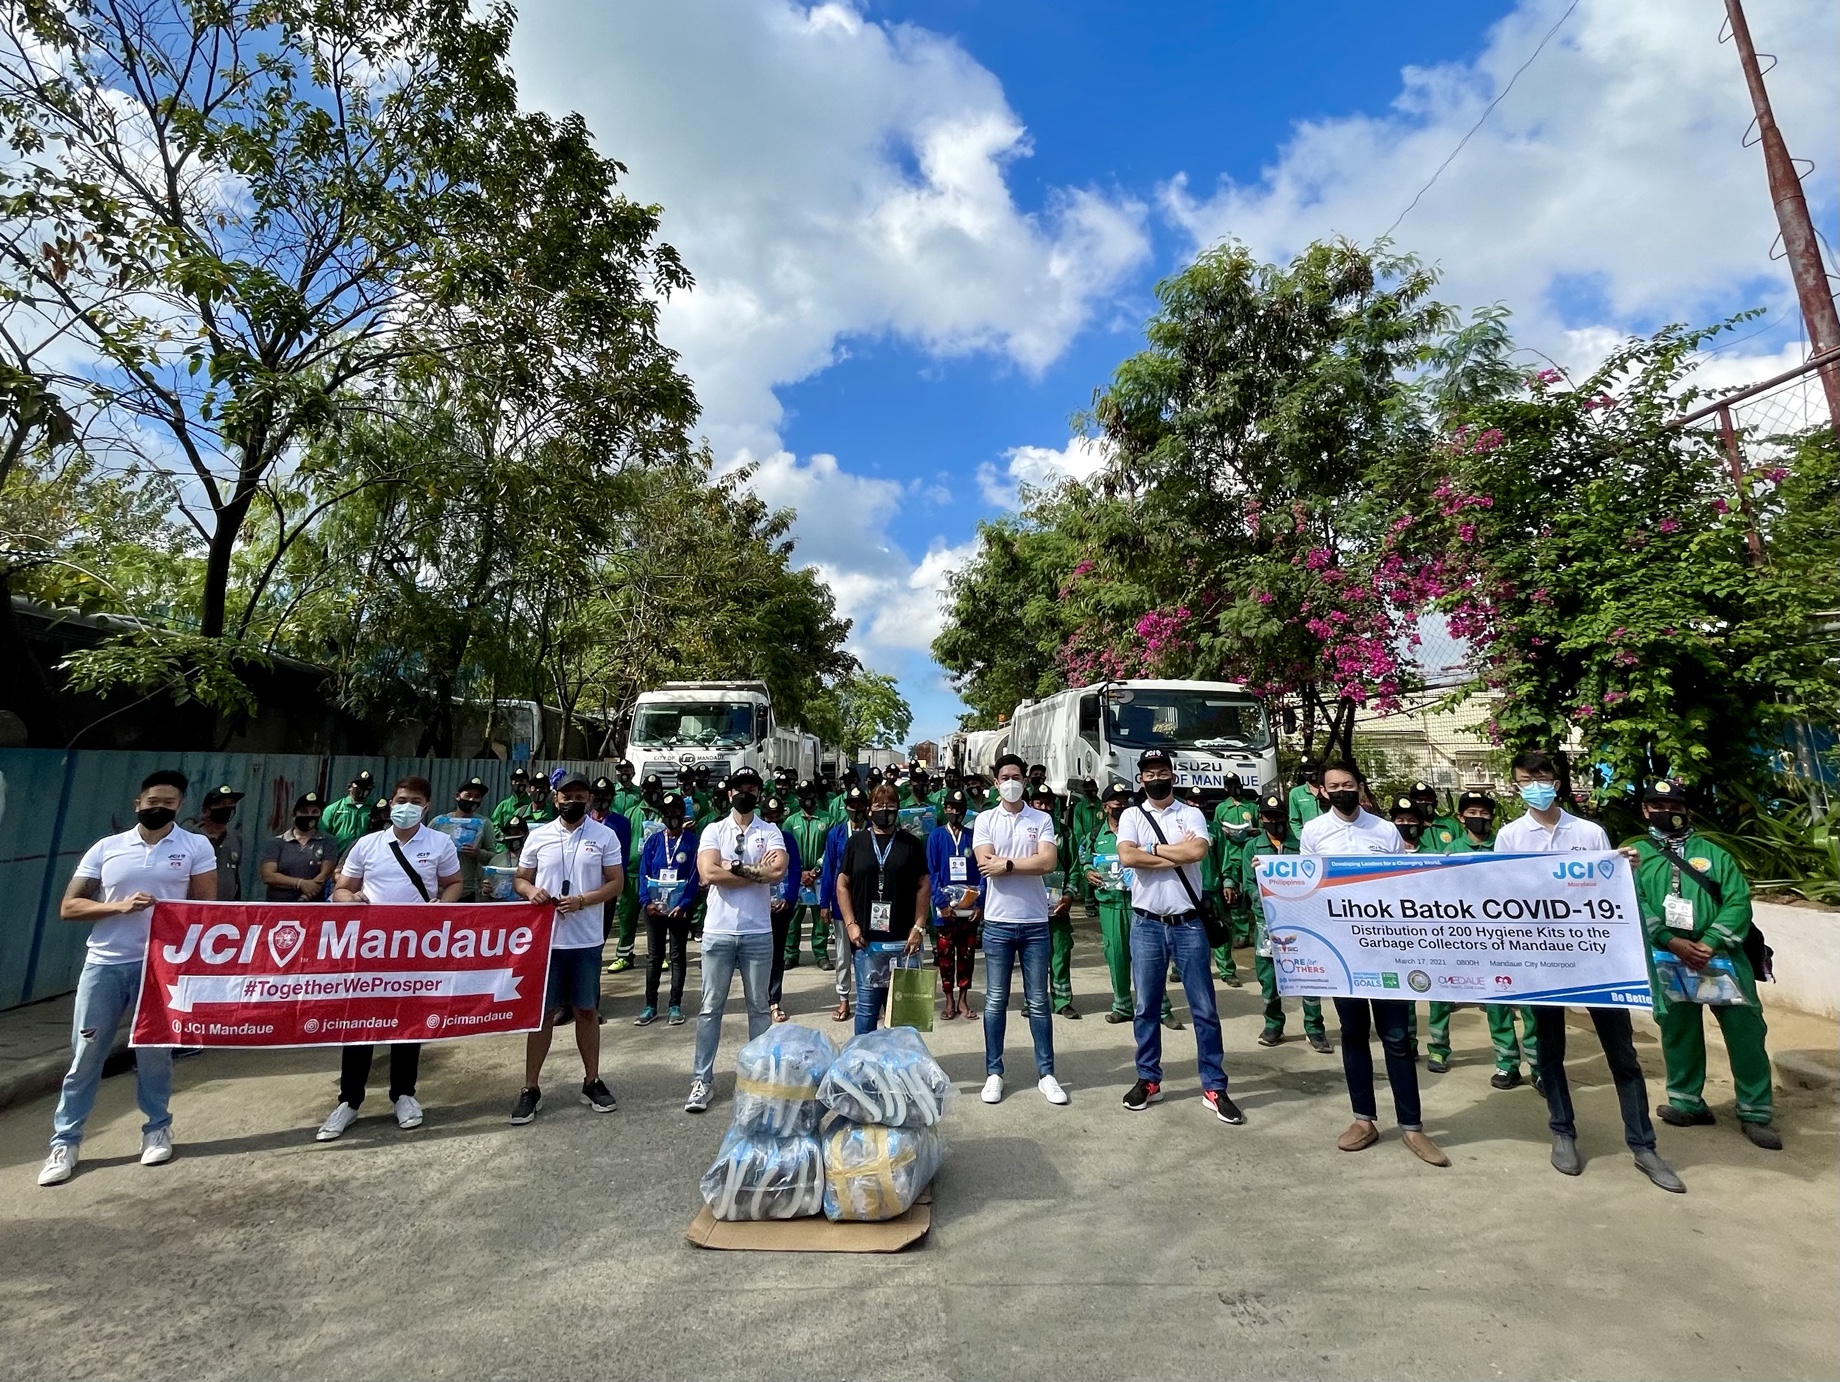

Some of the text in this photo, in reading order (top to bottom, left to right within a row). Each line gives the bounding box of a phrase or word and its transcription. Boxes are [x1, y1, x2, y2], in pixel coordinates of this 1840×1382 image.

[1145, 750, 1156, 758] JCI
[1174, 762, 1222, 772] ISUZU
[1192, 774, 1260, 787] MANUE
[1262, 861, 1298, 878] JCI
[1553, 861, 1594, 879] JCI
[1326, 899, 1624, 919] Lihok Batok COVID-19:
[1351, 925, 1611, 940] Distribution of 200 Hygiene Kits to the
[163, 924, 263, 964] JCI
[316, 920, 533, 961] Mandaue
[1359, 938, 1607, 954] Garbage Collectors of Mandaue City
[1418, 958, 1428, 966] 17,
[244, 977, 443, 998] #TogetherWeProsper
[1353, 979, 1382, 988] GOALS
[1610, 992, 1653, 1004] Be Bette
[321, 1016, 399, 1032] jcimandaue
[441, 1011, 514, 1028] jcimandaue
[184, 1022, 274, 1035] JCI Mandaue
